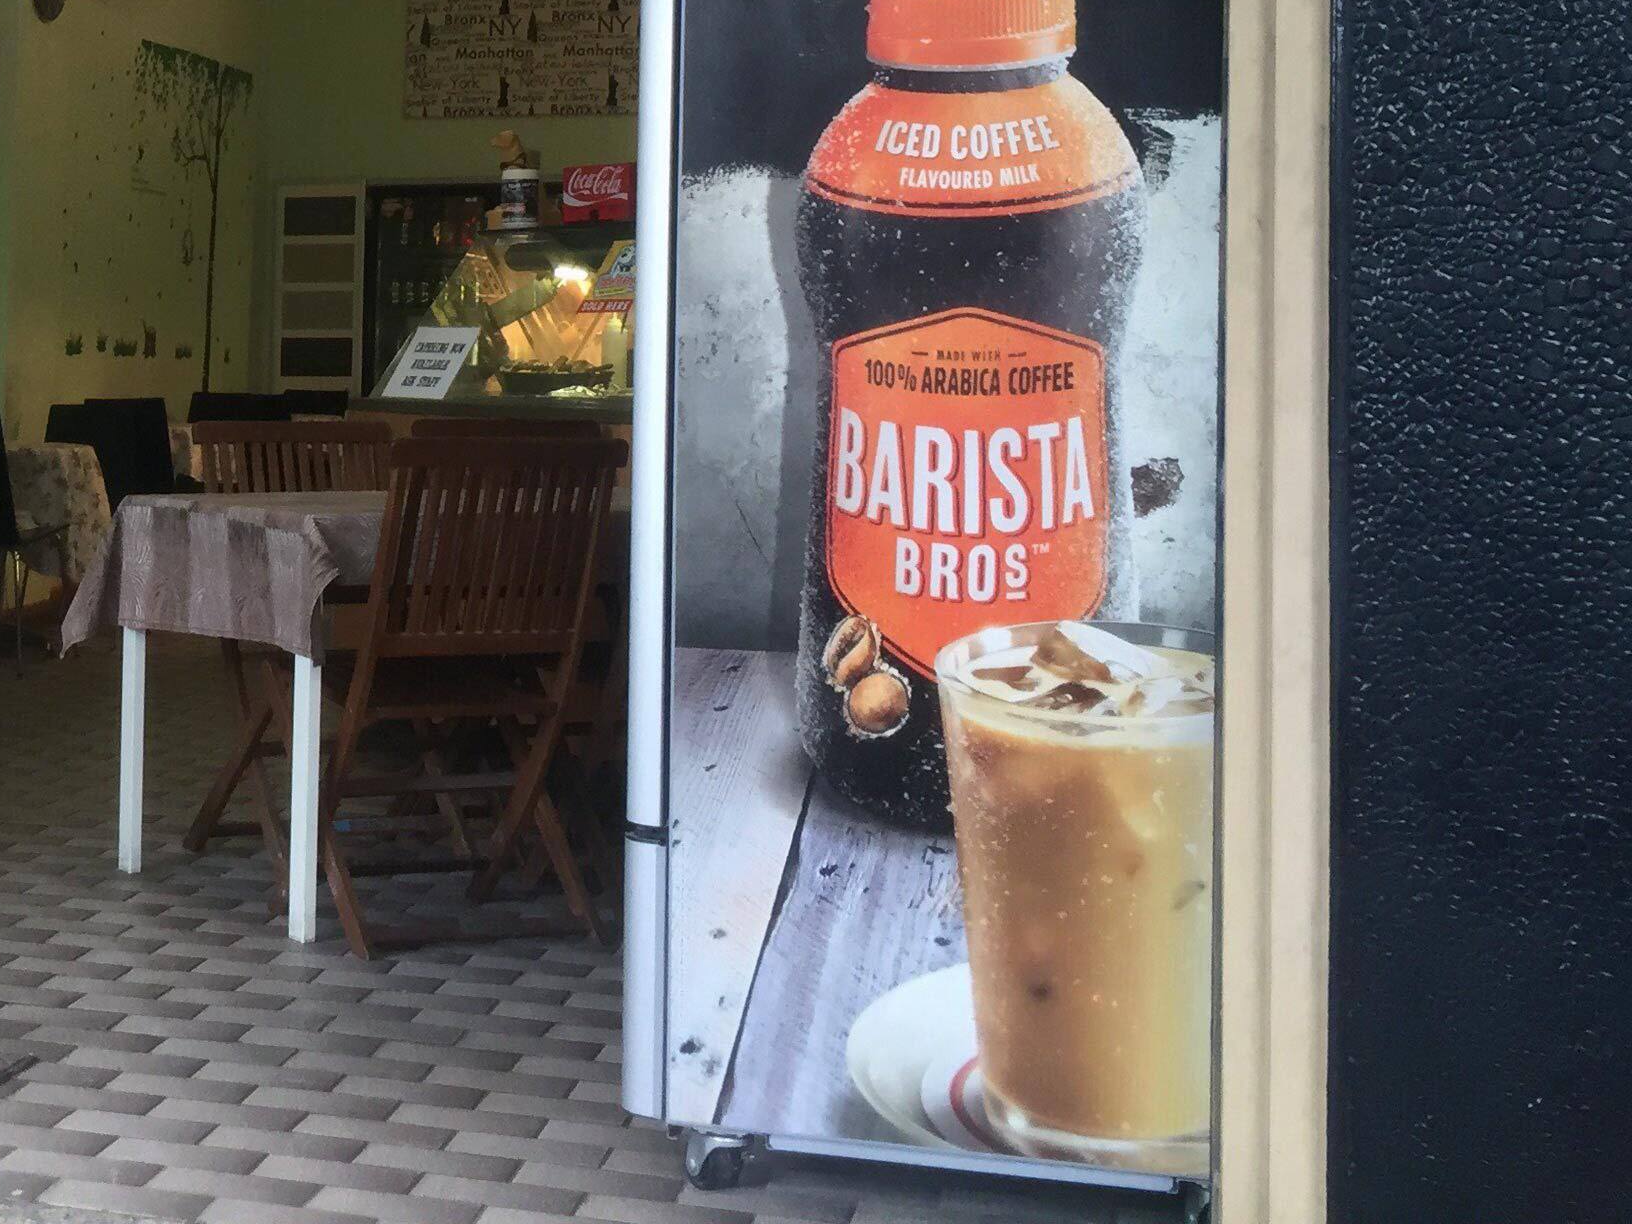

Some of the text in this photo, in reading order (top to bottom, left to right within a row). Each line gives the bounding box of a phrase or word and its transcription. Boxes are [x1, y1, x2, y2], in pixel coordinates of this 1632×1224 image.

[445, 14, 487, 26] Bronx
[552, 10, 595, 22] Bronx
[598, 15, 632, 33] NY
[489, 17, 522, 36] NY
[455, 46, 534, 60] Manhattan
[875, 115, 1060, 160] ICED COFFEE
[900, 165, 1040, 190] FLAVOURED MILK
[936, 350, 1001, 362] MADE WITH
[864, 359, 1074, 397] 100% ARABICA COFFEE
[835, 407, 1095, 535] BARISTA
[895, 536, 1030, 603] BROS
